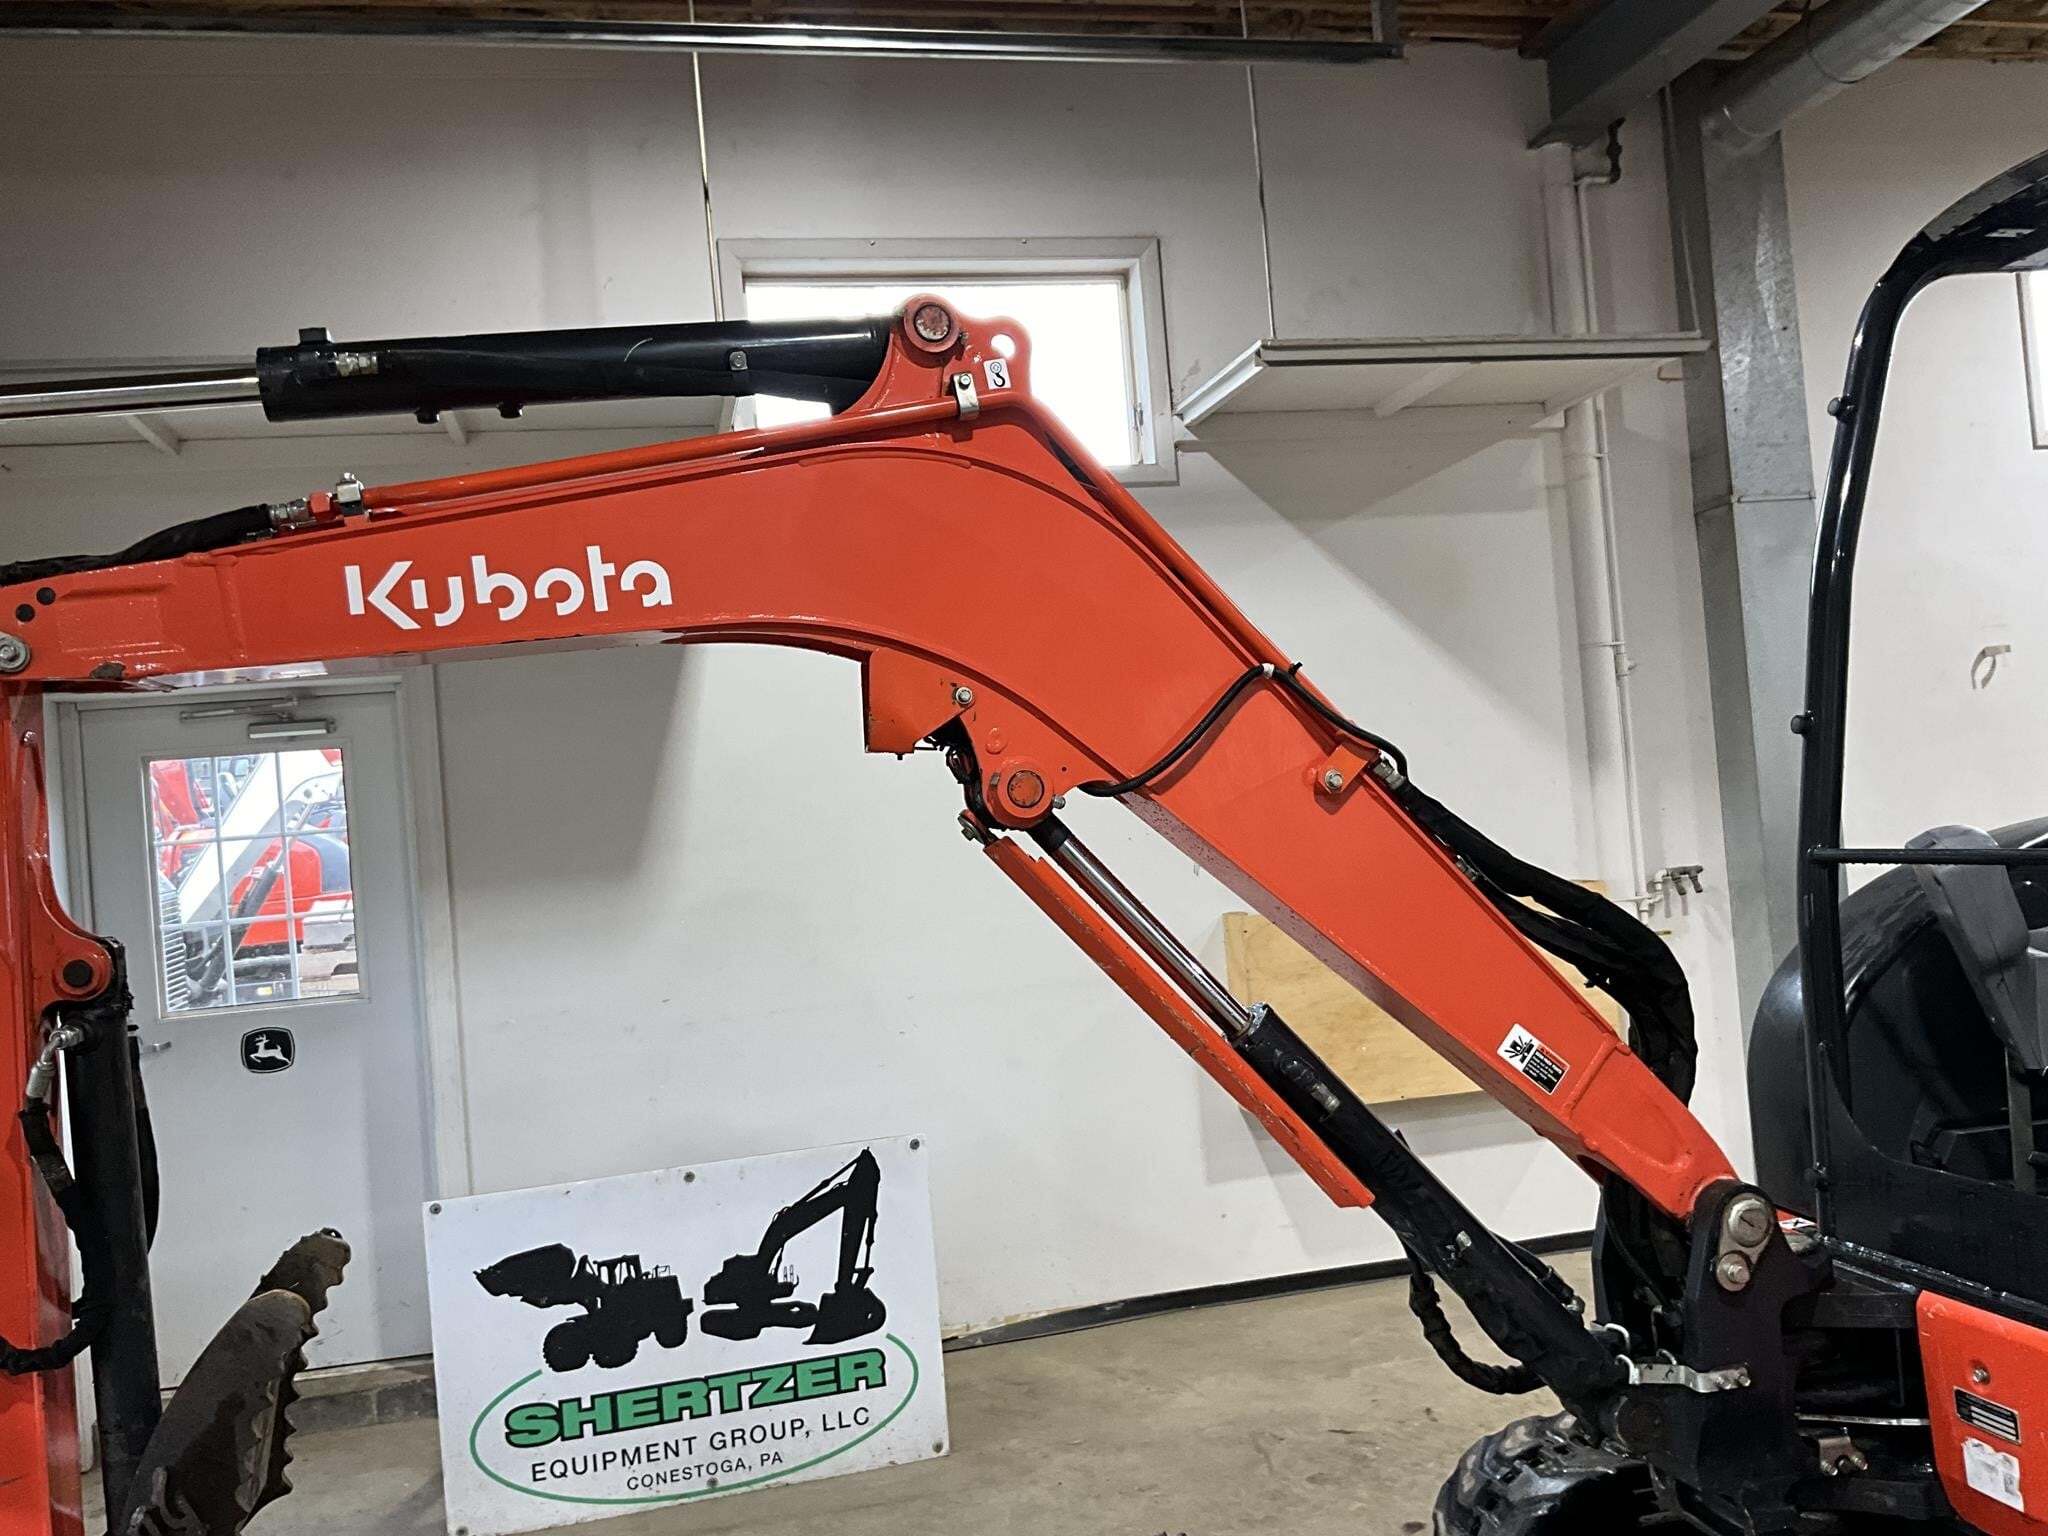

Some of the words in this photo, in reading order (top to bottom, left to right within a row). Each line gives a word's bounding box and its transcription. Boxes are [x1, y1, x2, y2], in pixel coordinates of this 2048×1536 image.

[344, 545, 673, 630] Kubota
[505, 1348, 886, 1448] SHERTZER
[531, 1437, 697, 1482] EQUIPMENT
[710, 1418, 810, 1451] GROUP,
[822, 1406, 871, 1433] LLC
[626, 1458, 752, 1491] CONESTOGA,
[760, 1452, 783, 1470] PA
